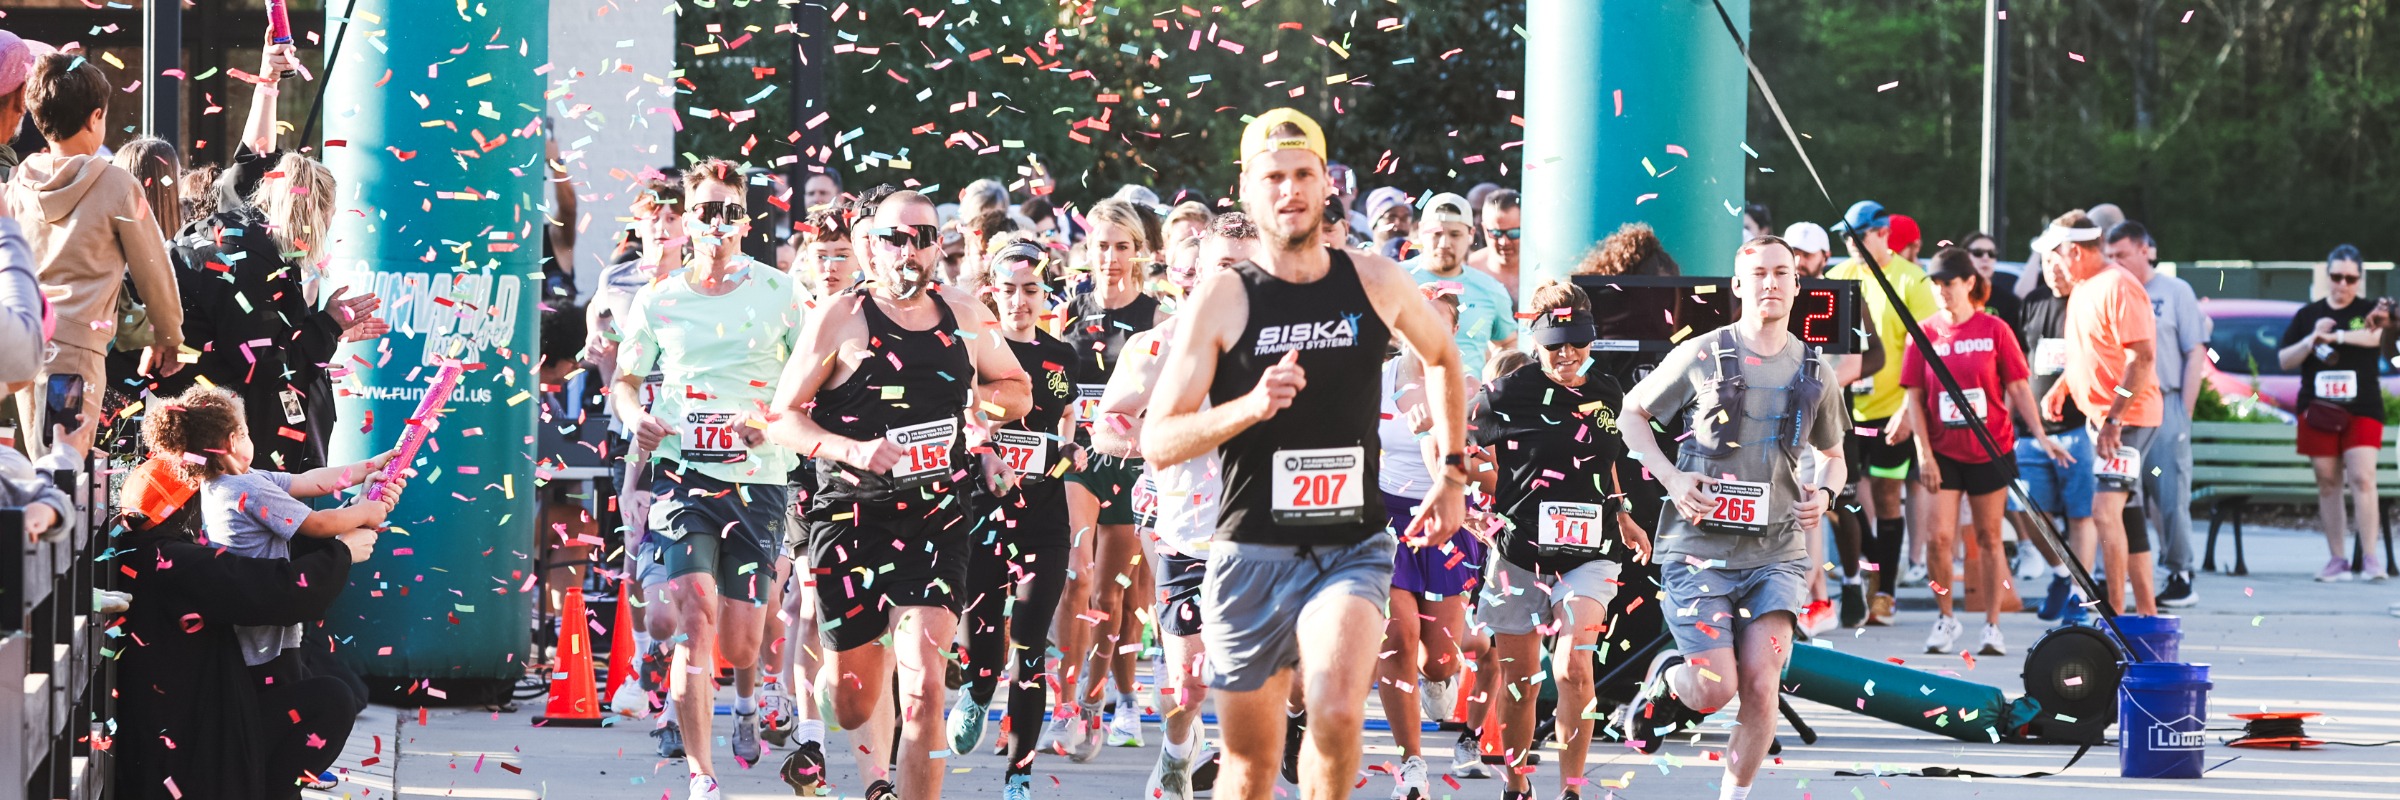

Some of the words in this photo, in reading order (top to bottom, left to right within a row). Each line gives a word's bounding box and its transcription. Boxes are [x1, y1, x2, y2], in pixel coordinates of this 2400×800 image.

[1804, 290, 1835, 342] 2
[1257, 319, 1355, 346] SISKA
[1254, 342, 1303, 356] TRAINING
[1306, 337, 1354, 350] SYSTEMS
[345, 386, 492, 403] www.rund.us
[2325, 383, 2348, 397] 164
[694, 426, 733, 449] 176
[1292, 473, 1347, 506] 207
[1713, 496, 1756, 522] 265
